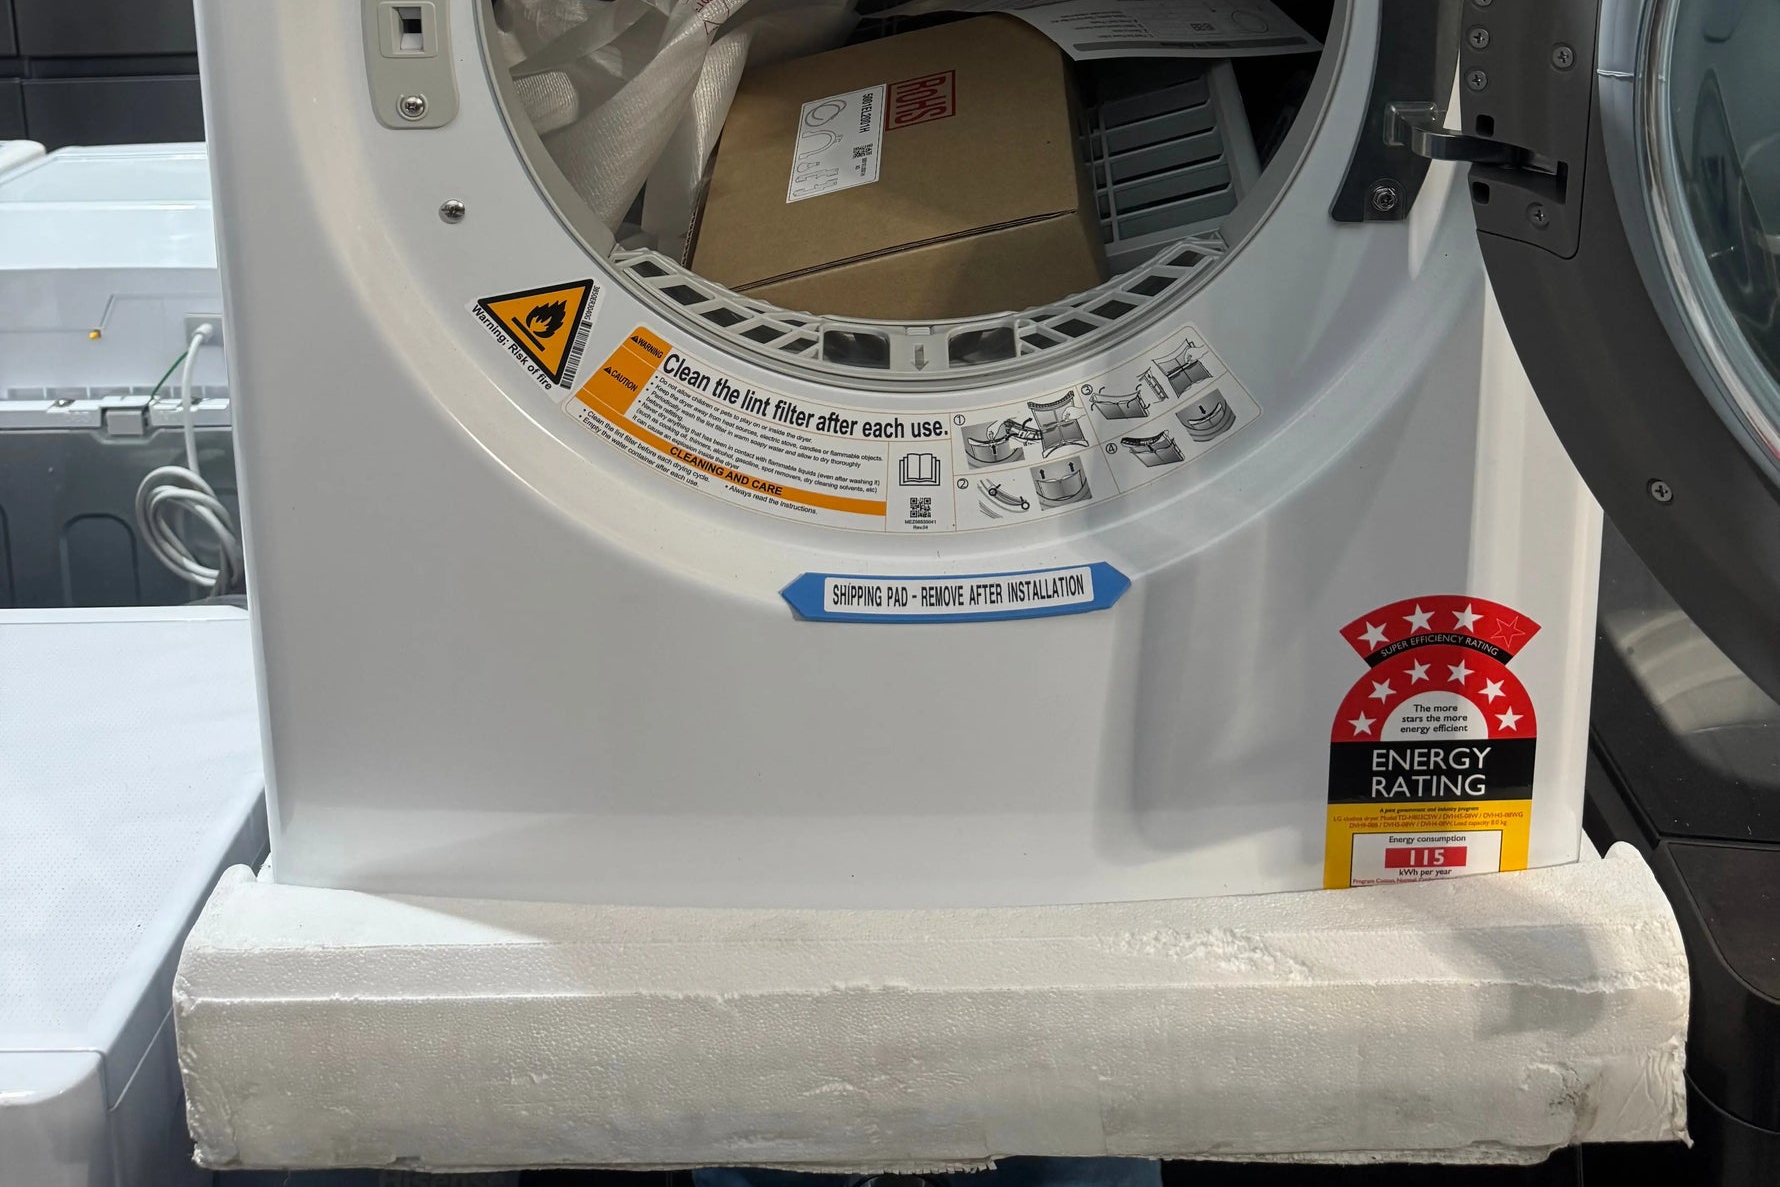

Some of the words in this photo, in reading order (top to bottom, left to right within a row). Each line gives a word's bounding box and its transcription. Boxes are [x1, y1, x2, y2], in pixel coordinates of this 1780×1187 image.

[637, 337, 663, 358] WARNING
[507, 343, 528, 365] Risk
[527, 364, 540, 375] of
[536, 373, 552, 390] fire
[610, 369, 638, 392] CAUTION
[658, 376, 668, 385] Do
[667, 383, 678, 391] not
[676, 388, 691, 398] allow
[691, 396, 713, 409] children
[719, 409, 732, 418] pets
[739, 417, 752, 426] play
[768, 427, 785, 436] inside
[663, 353, 711, 392] Clean
[711, 377, 740, 404] the
[740, 388, 770, 417] lint
[772, 399, 815, 428] filter
[815, 411, 858, 436] after
[862, 417, 904, 438] each
[910, 420, 948, 438] use.
[582, 416, 602, 433] Empty
[600, 430, 611, 439] the
[611, 437, 628, 449] water
[627, 447, 655, 465] container
[655, 463, 670, 473] after
[669, 470, 686, 481] each
[685, 478, 698, 486] use.
[587, 410, 604, 425] Clean
[604, 422, 614, 432] the
[613, 428, 624, 438] lint
[623, 434, 638, 446] filter
[637, 442, 657, 457] before
[656, 455, 672, 465] each
[672, 462, 692, 475] drying
[692, 471, 710, 482] cycle.
[669, 446, 724, 476] CLEANING
[724, 470, 749, 485] AND
[751, 479, 783, 496] CARE
[728, 485, 752, 497] Always
[752, 493, 768, 502] read
[768, 497, 779, 505] the
[833, 583, 882, 607] SHIPPING
[887, 586, 908, 607] PAD
[921, 585, 963, 606] REMOVE
[969, 583, 1002, 605] AFTER
[1007, 573, 1084, 603] INSTALLATION
[1381, 641, 1408, 657] SUPER
[1411, 634, 1463, 645] EFFICIENCY
[1465, 638, 1499, 656] RATING
[1414, 704, 1431, 712] The
[1400, 726, 1430, 734] energy
[1372, 747, 1491, 771] ENERGY
[1372, 774, 1486, 798] RATING
[1389, 836, 1414, 845] Energy
[1417, 835, 1466, 844] consumption
[1410, 849, 1444, 865] 115
[1420, 869, 1433, 878] per
[1435, 869, 1452, 877] year
